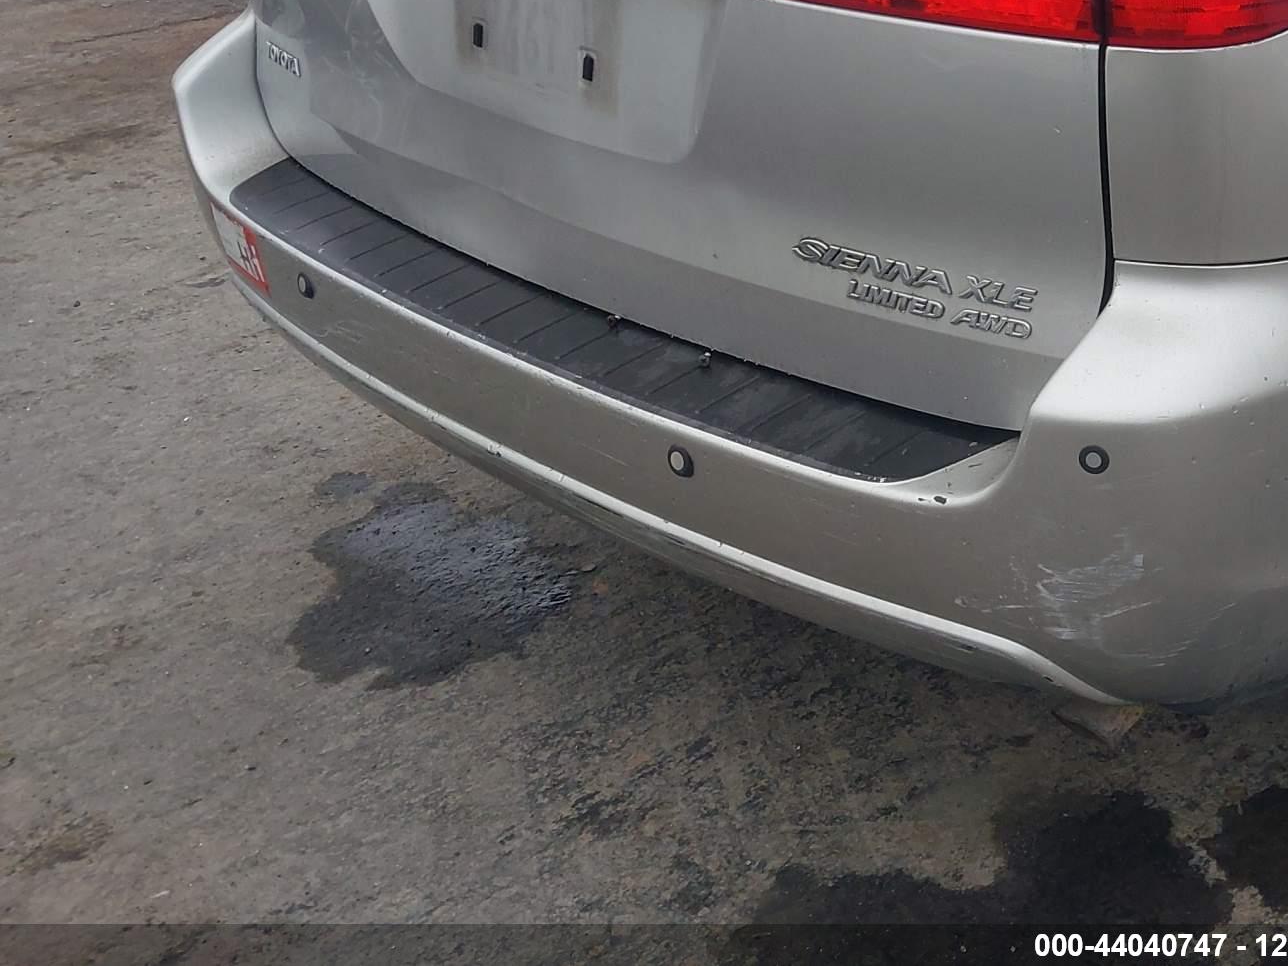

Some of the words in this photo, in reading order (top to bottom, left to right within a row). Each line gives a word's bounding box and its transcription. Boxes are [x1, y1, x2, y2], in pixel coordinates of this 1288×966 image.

[266, 40, 301, 77] TOYOTA
[792, 237, 953, 295] SIENNA
[959, 275, 1038, 312] XLE
[847, 279, 946, 319] LIMITED
[950, 308, 1033, 339] AWD
